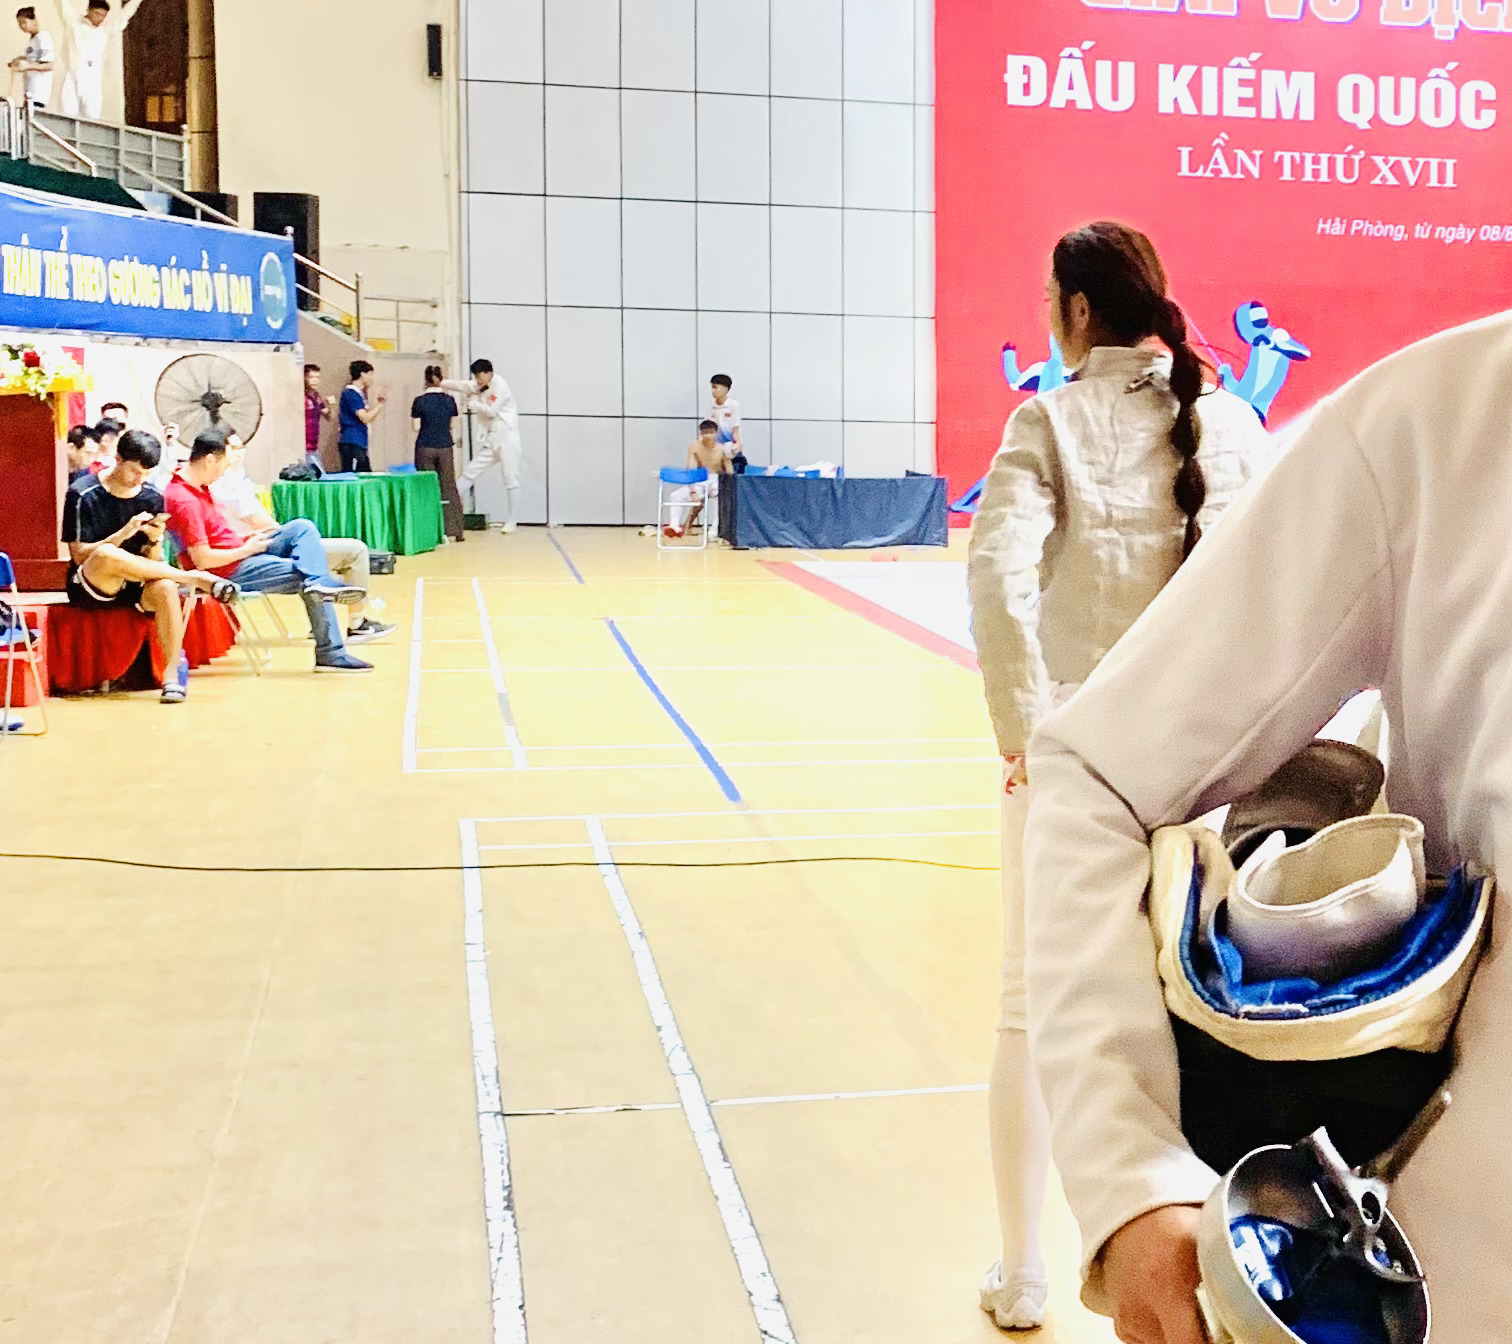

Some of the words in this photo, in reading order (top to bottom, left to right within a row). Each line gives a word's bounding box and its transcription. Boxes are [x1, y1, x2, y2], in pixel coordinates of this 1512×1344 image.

[1003, 40, 1135, 112] ĐẤU
[1158, 52, 1316, 121] KIẾM
[1337, 61, 1497, 130] QUỐC
[1176, 132, 1264, 179] LẦN
[1273, 144, 1365, 184] THỨ
[1369, 155, 1458, 188] XVII
[1316, 217, 1346, 236] Hải
[1350, 219, 1409, 241] Phòng,
[1414, 221, 1431, 239] từ
[1435, 223, 1476, 244] ngày
